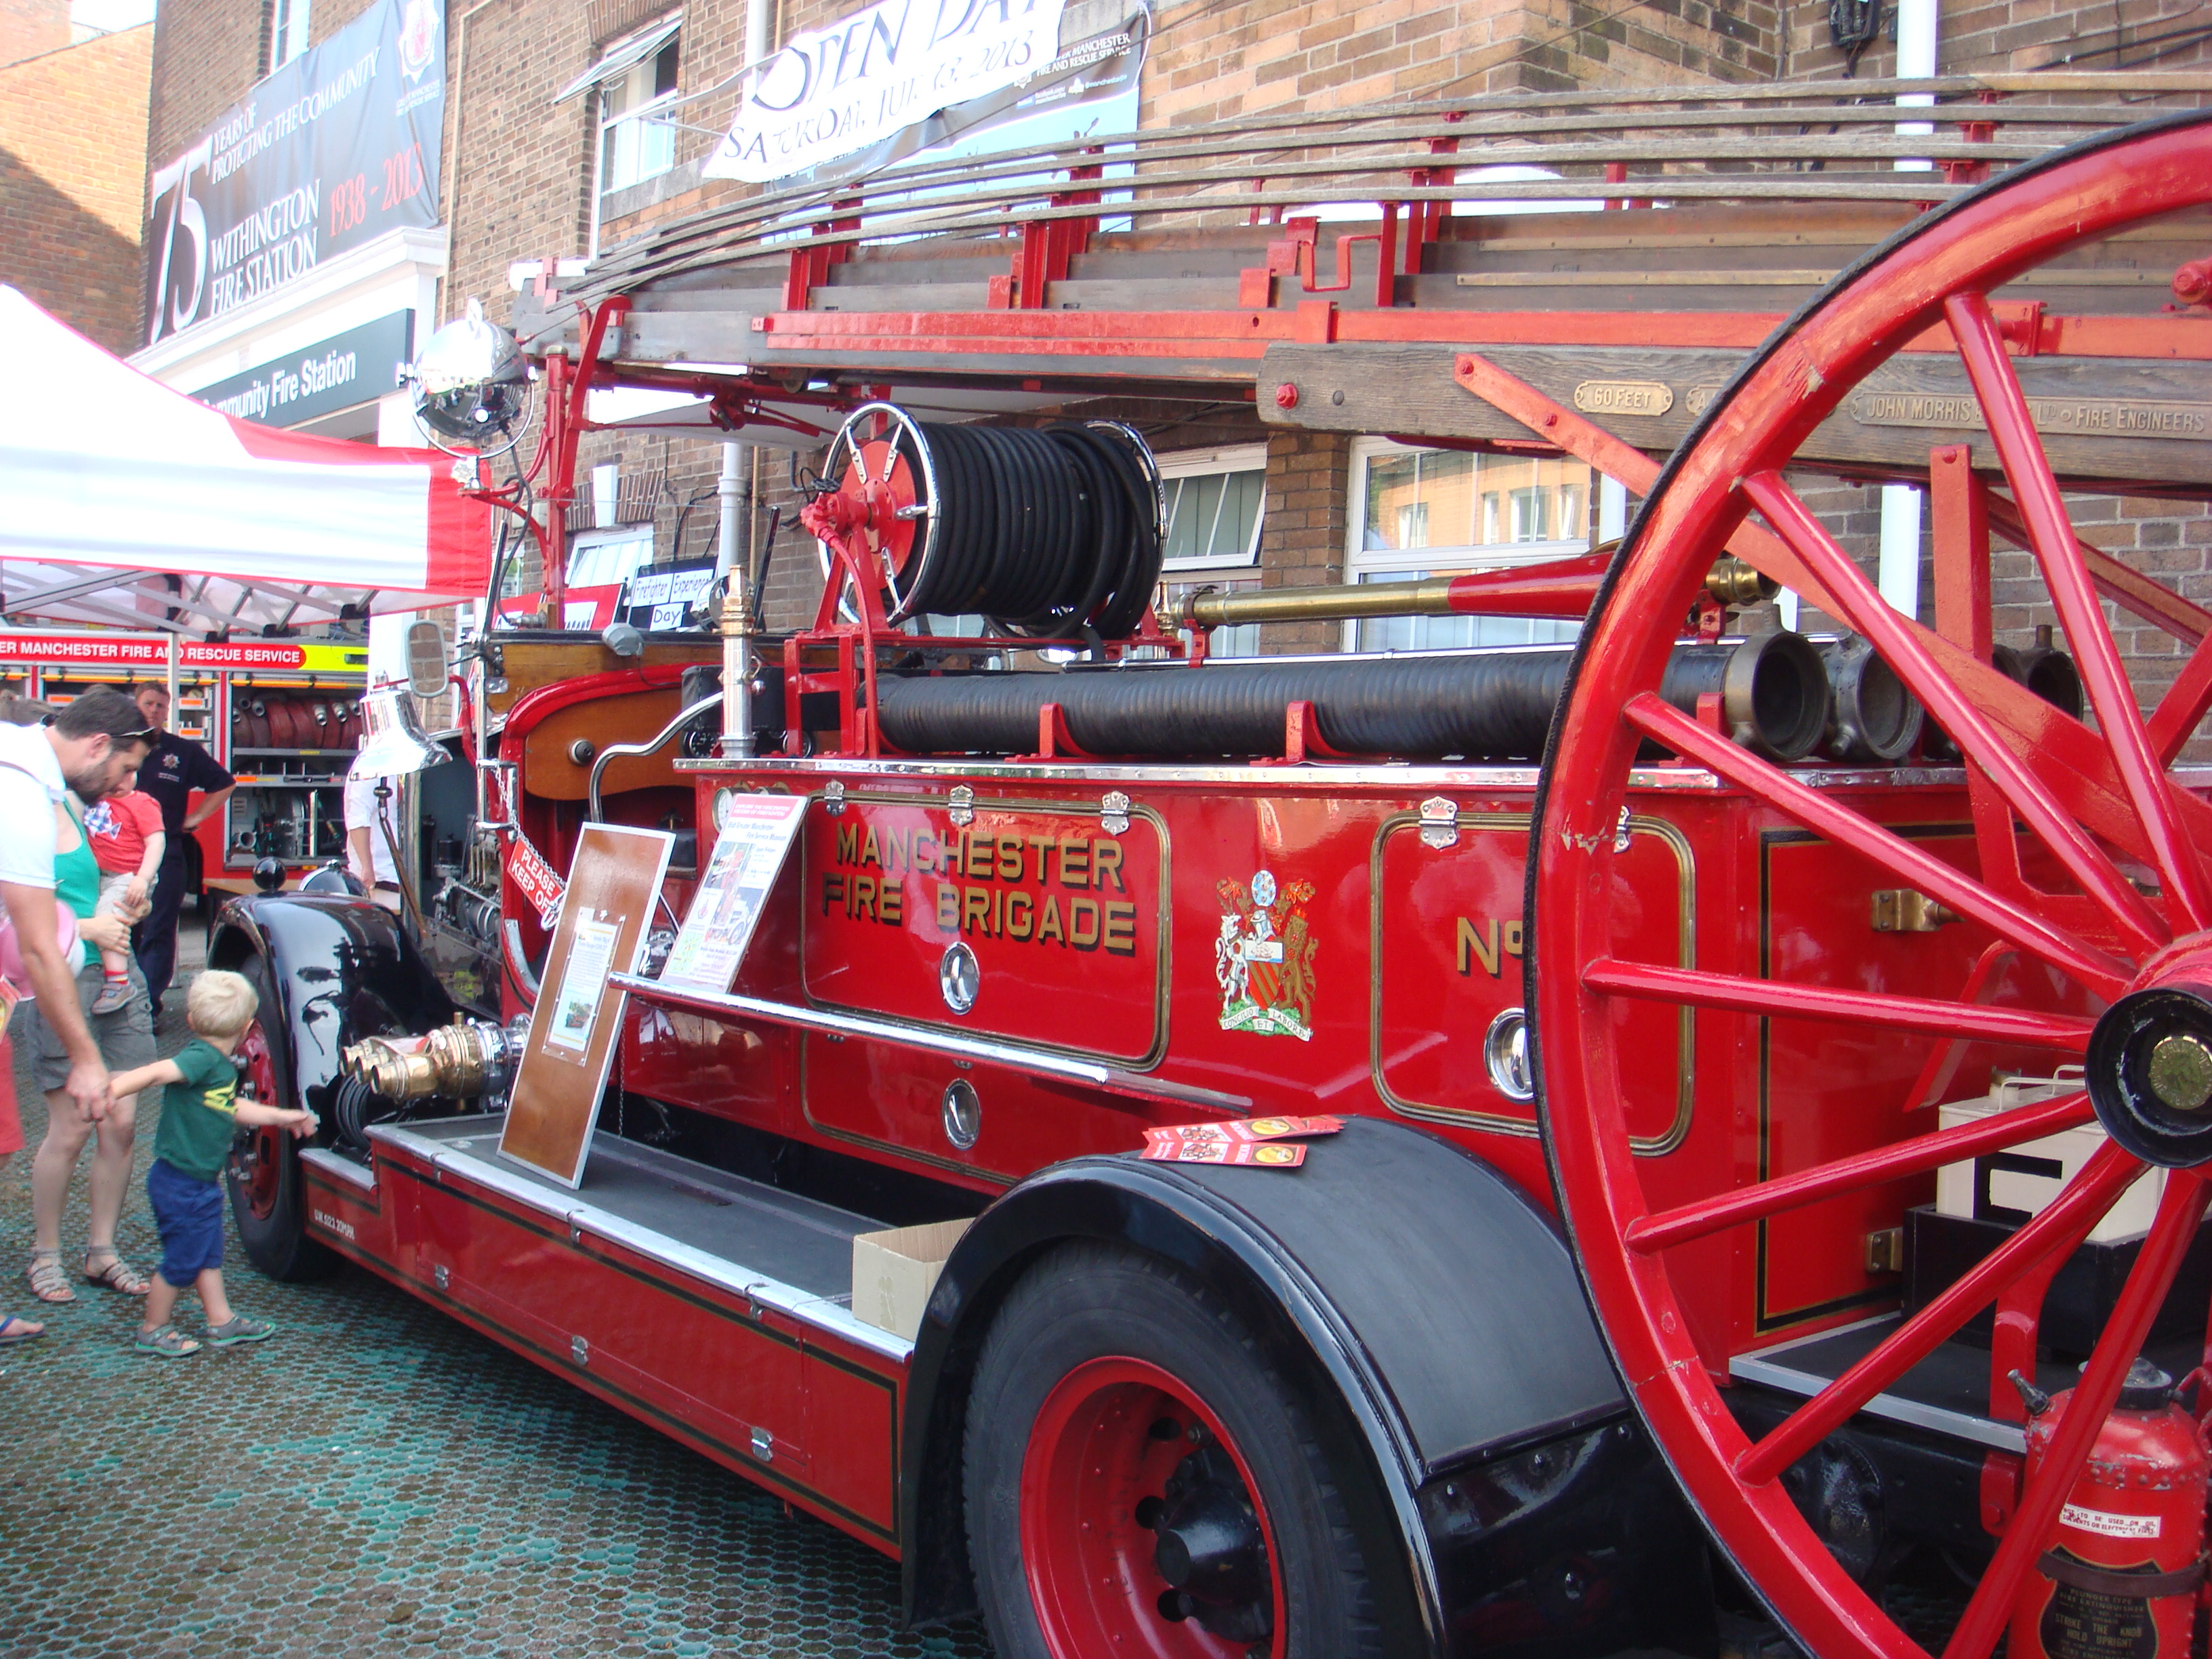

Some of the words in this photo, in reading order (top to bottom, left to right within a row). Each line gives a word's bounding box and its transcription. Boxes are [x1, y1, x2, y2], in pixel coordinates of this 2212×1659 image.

[1036, 64, 1051, 77] FIRE
[1052, 60, 1069, 73] AND
[1069, 52, 1098, 68] RESCUE
[1071, 33, 1130, 57] MANCHESTER
[212, 121, 274, 185] PROTECTING
[274, 104, 299, 142] THE
[299, 47, 381, 125] COMMUNITY
[213, 117, 244, 156] YEARS
[245, 102, 257, 134] OF
[210, 178, 322, 274] WITHINGTON
[329, 173, 367, 238] 1938
[382, 142, 423, 211] 2013
[150, 133, 213, 345] 75
[211, 270, 245, 317] FIRE
[246, 226, 319, 301] STATION
[203, 380, 270, 419] mmunity
[272, 369, 300, 407] Fire
[301, 350, 356, 397] Station
[1594, 387, 1613, 407] 60
[1615, 388, 1652, 408] FEET
[1866, 397, 1906, 419] JOHN
[1910, 399, 1972, 422] MORRIS
[2075, 406, 2112, 430] FIRE
[2116, 407, 2205, 432] ENGINEERS
[653, 609, 681, 626] Day
[21, 642, 118, 657] MANCHESTER
[121, 644, 152, 658] FIRE
[155, 646, 184, 659] AD
[188, 647, 242, 661] RESCUE
[245, 649, 300, 663] SERVICE
[520, 848, 556, 897] PLEASE
[836, 822, 1125, 890] MANCHESTER
[512, 859, 535, 892] KEEP
[535, 890, 550, 910] OF
[822, 872, 903, 921] FIRE
[936, 882, 1135, 954] BRIGADE
[1223, 1008, 1254, 1029] CONCILIO
[1257, 1020, 1269, 1029] ET
[1272, 1010, 1306, 1038] LABORE
[2055, 1613, 2083, 1630] STRIKE
[2092, 1622, 2109, 1635] THE
[2119, 1627, 2143, 1637] KNOB
[2067, 1629, 2088, 1643] HOLD
[2095, 1635, 2133, 1648] UPRIGHT
